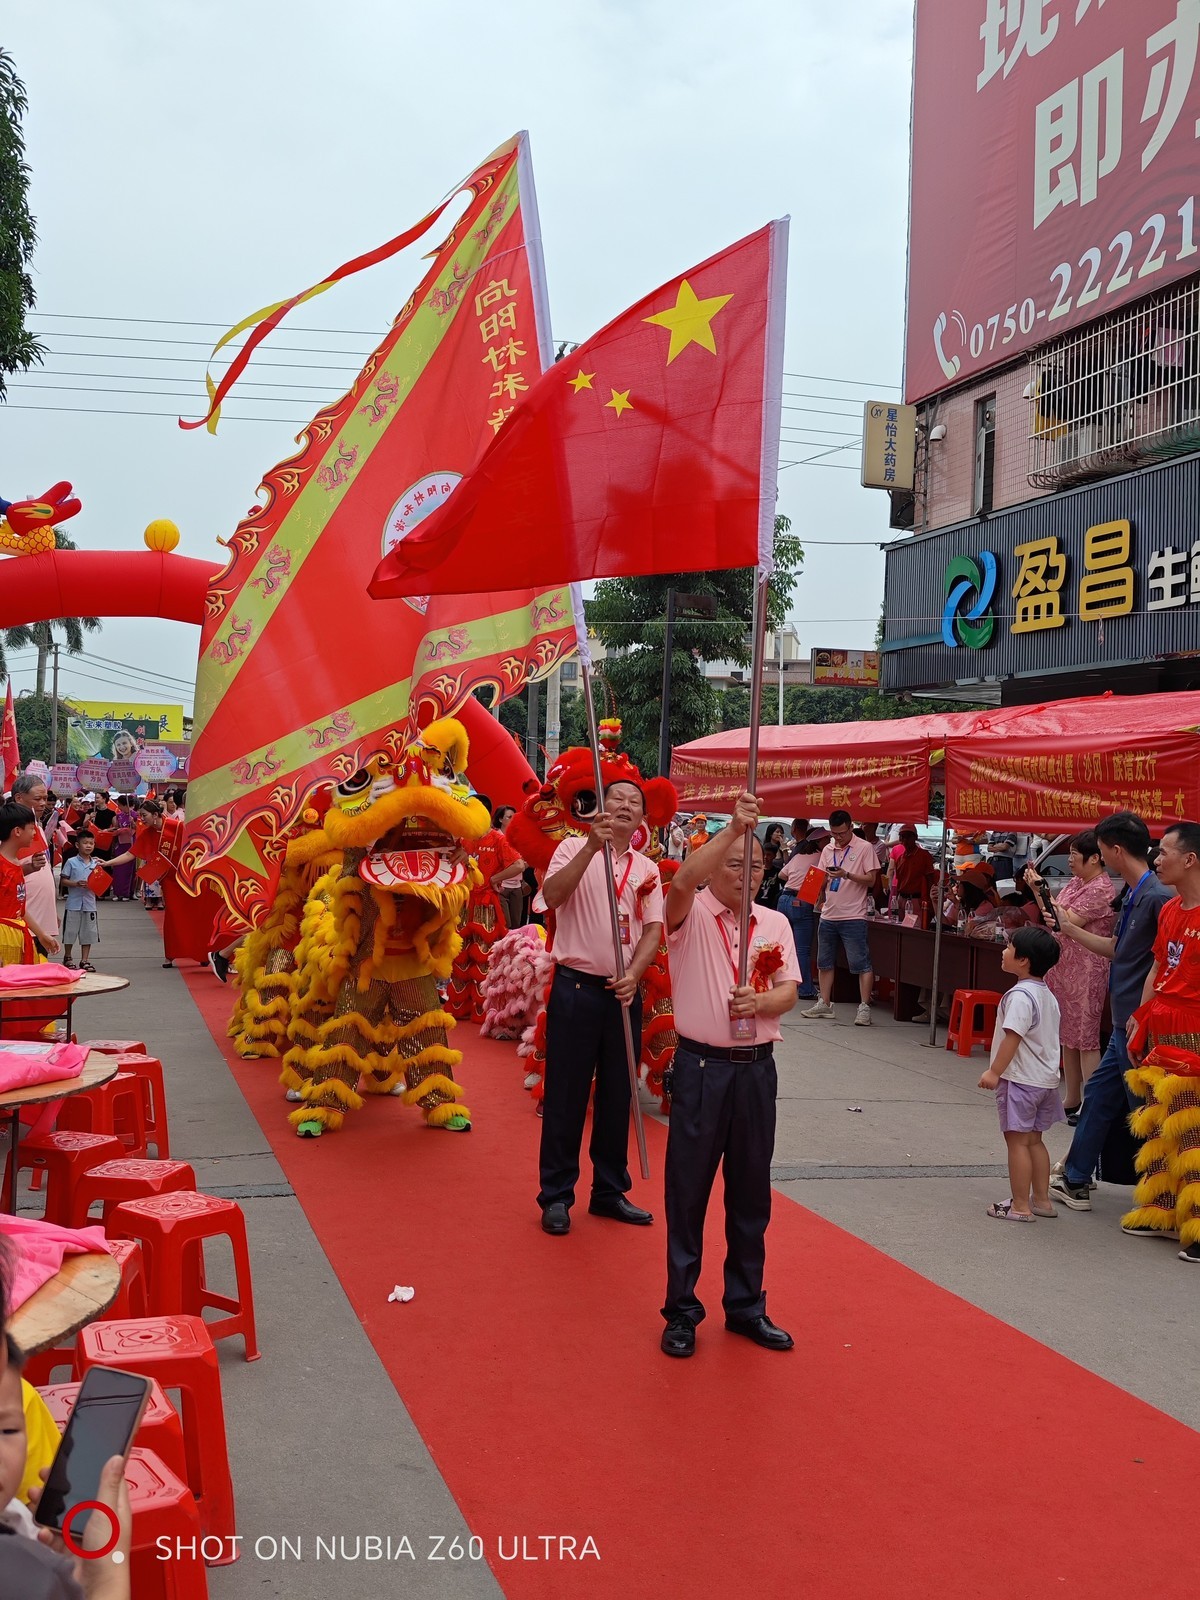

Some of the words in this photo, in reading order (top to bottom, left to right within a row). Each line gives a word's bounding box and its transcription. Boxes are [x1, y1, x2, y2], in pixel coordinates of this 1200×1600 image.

[883, 408, 898, 482] 星怡大药房
[1010, 518, 1135, 635] 盈昌
[683, 783, 747, 801] 接待报到
[805, 785, 882, 808] 捐款处
